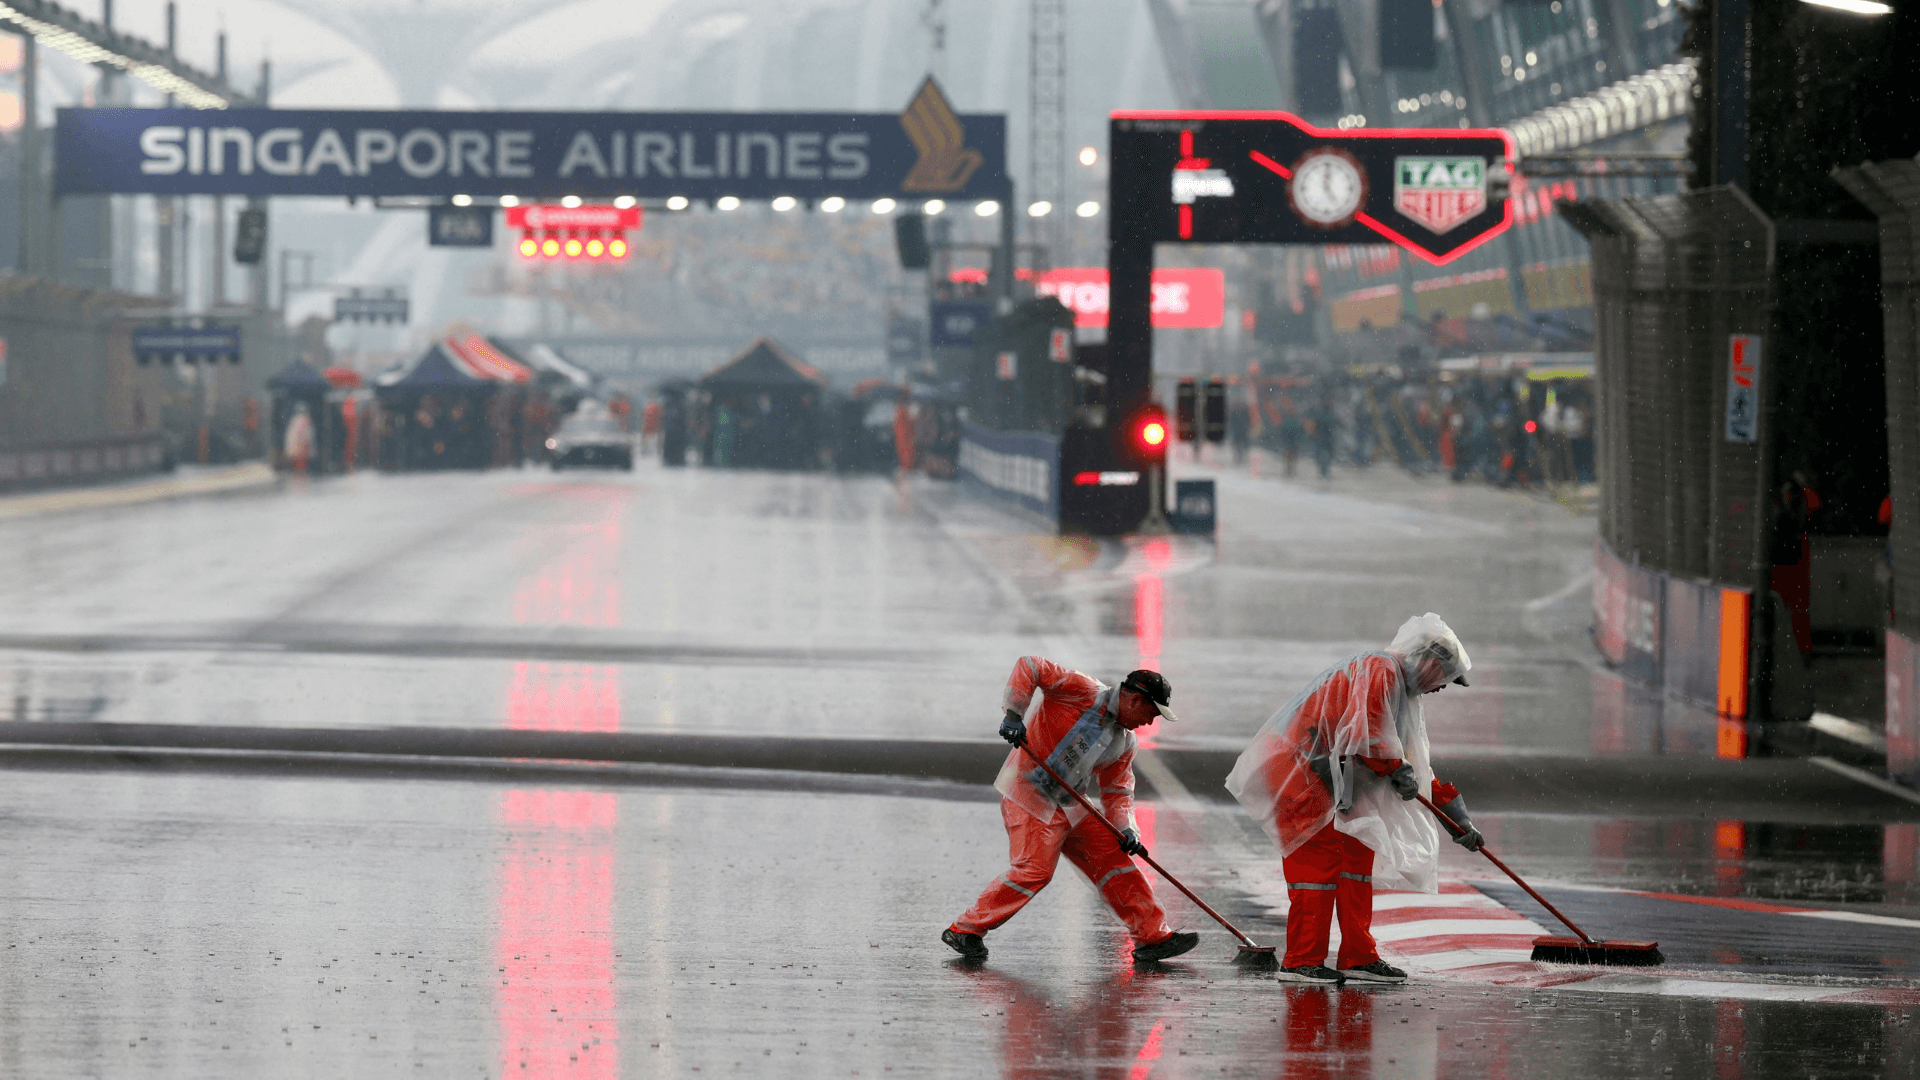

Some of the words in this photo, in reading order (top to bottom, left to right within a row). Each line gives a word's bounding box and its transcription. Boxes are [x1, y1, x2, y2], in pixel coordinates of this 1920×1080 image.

[139, 126, 534, 178] SINGAPORE
[557, 131, 870, 179] AIRLINES
[1405, 161, 1477, 188] TAG
